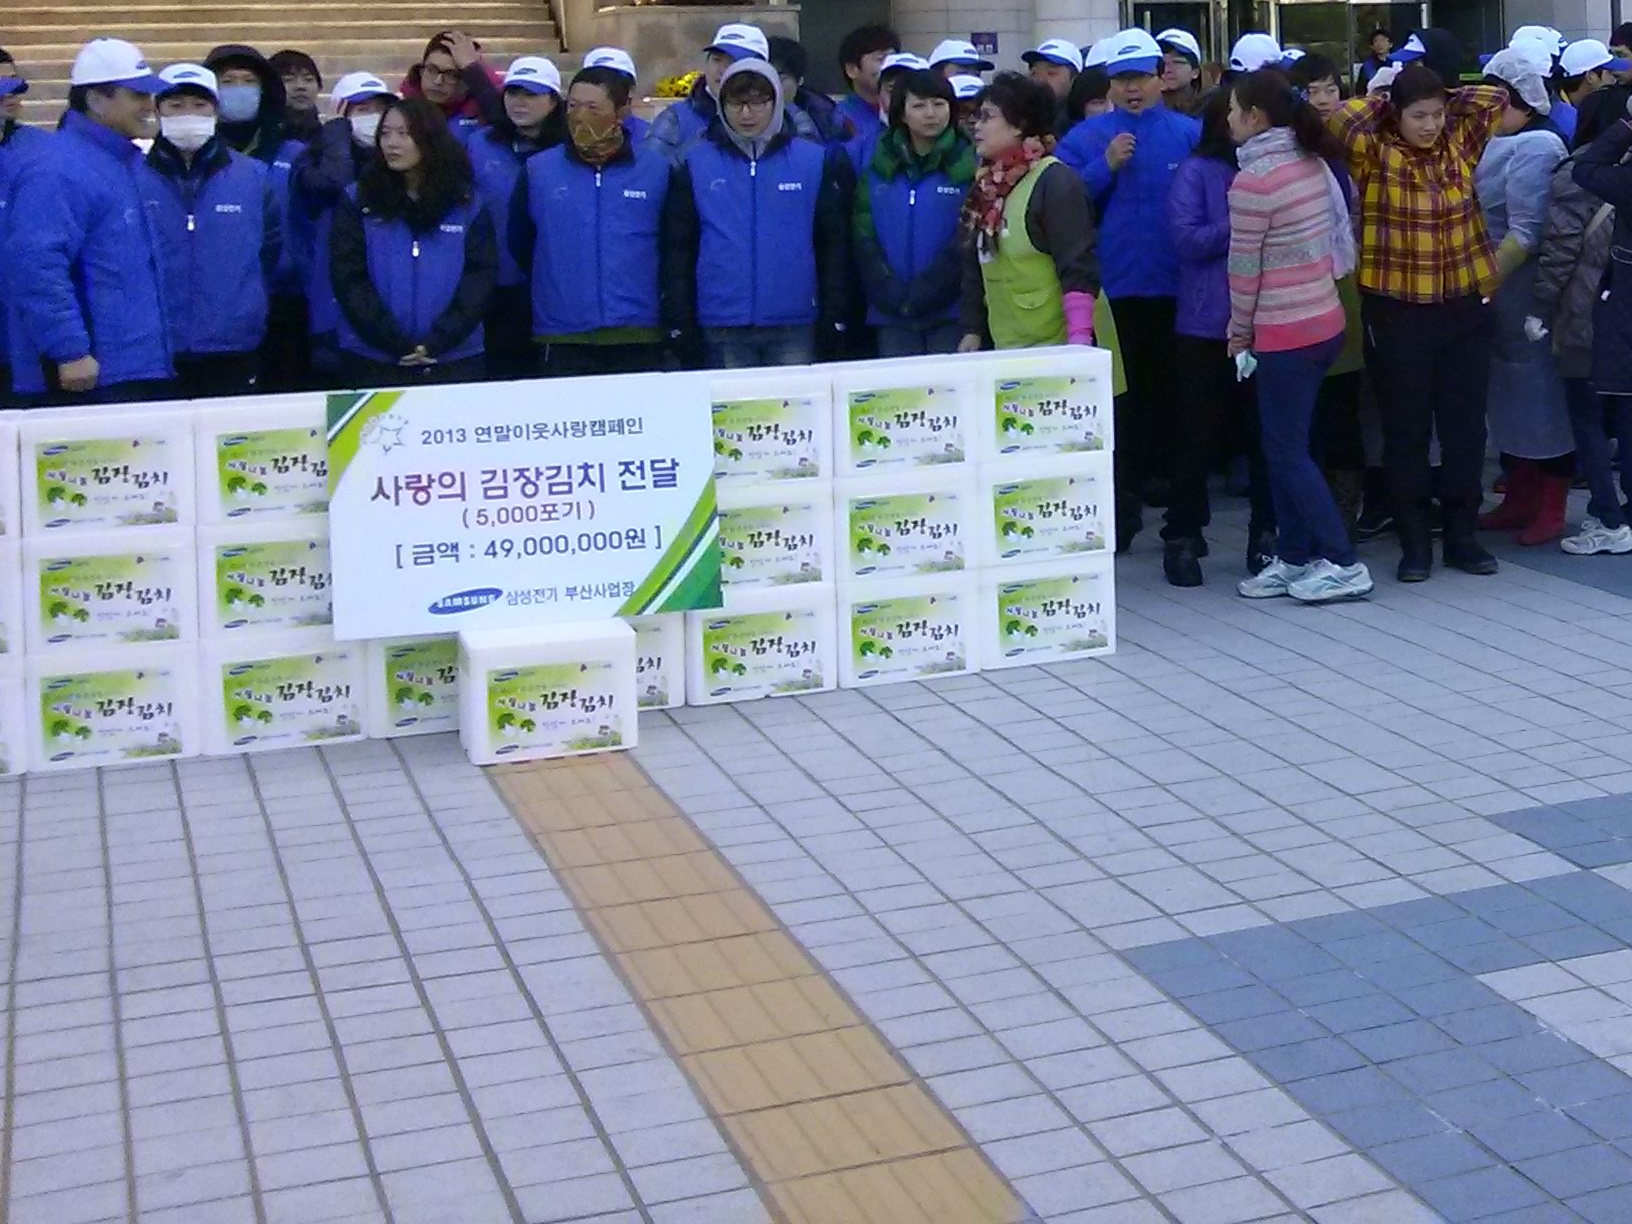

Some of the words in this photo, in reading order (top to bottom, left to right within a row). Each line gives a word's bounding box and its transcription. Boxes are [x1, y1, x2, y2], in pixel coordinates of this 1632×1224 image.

[421, 428, 467, 445] 2013
[474, 416, 644, 443] 연말이웃사랑캠페인
[370, 470, 467, 506] 사랑의
[480, 461, 606, 499] 김장김치
[617, 457, 680, 491] 전달
[505, 587, 558, 606] 삼성전기
[565, 580, 635, 601] 부산사업장
